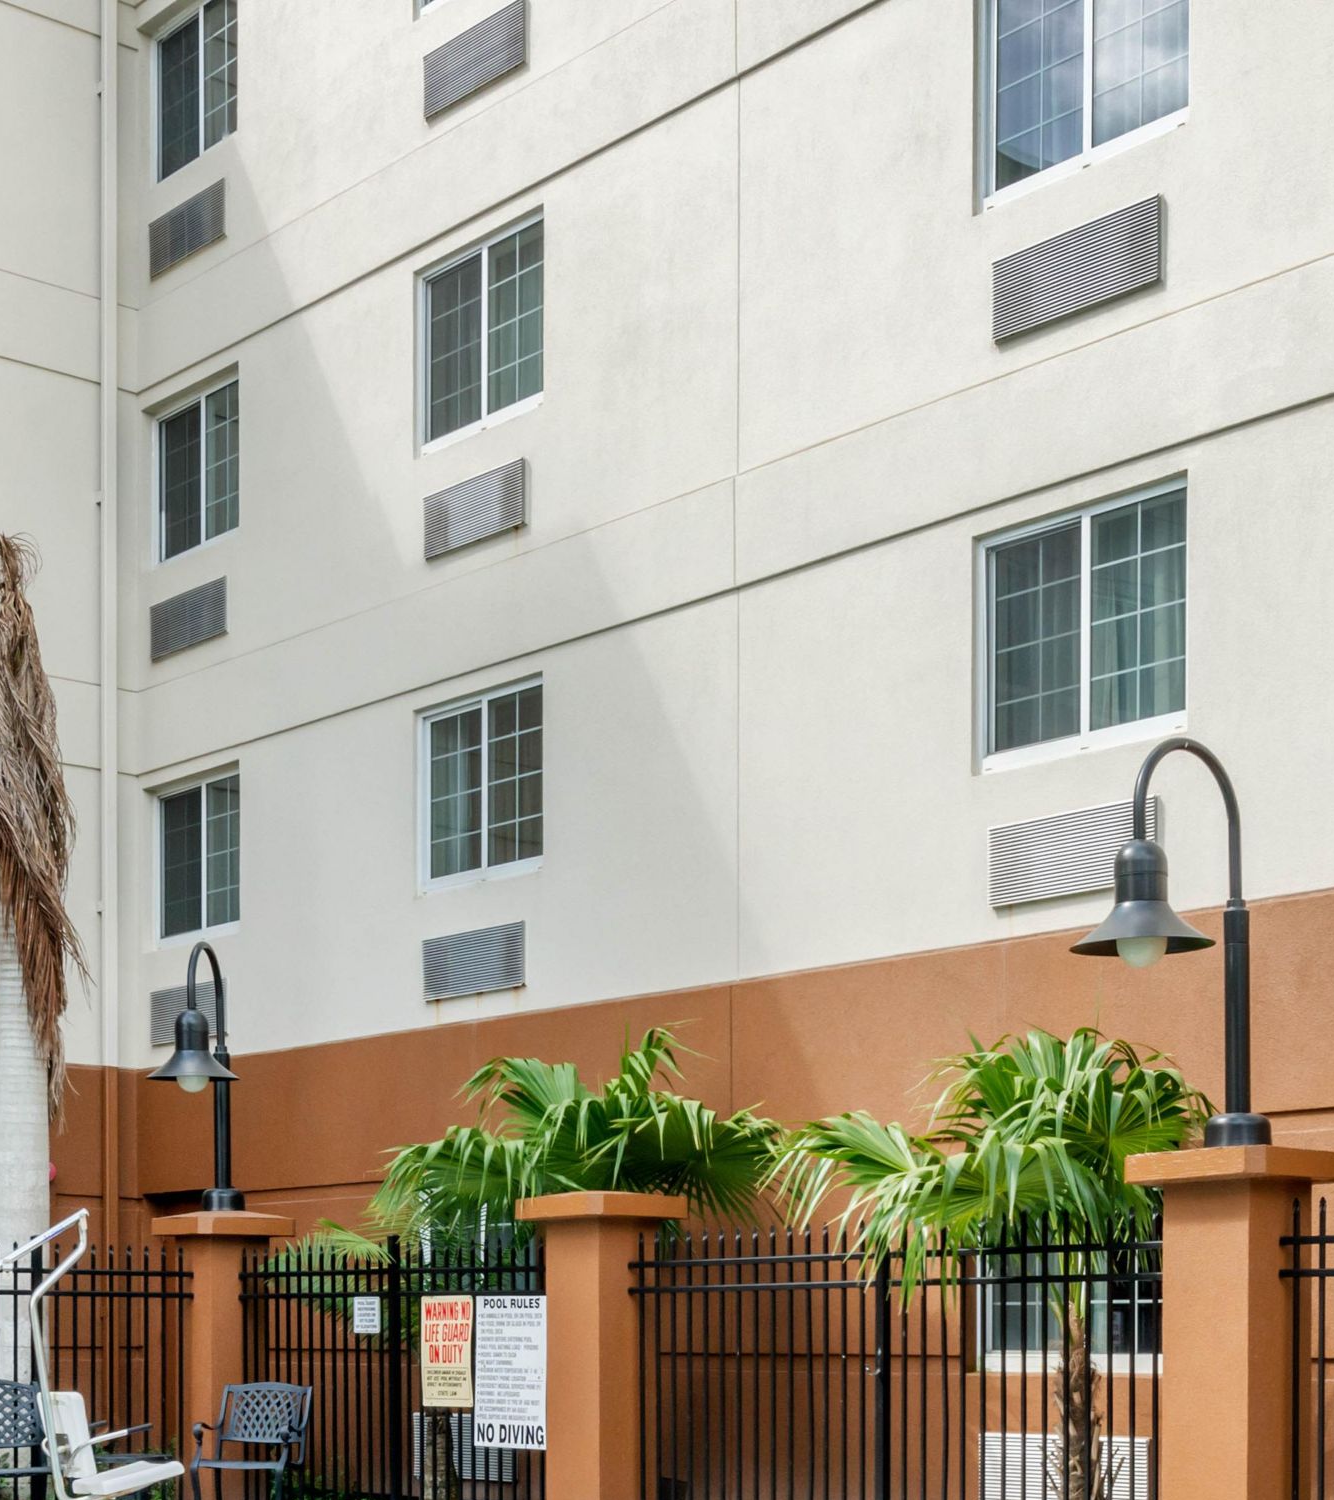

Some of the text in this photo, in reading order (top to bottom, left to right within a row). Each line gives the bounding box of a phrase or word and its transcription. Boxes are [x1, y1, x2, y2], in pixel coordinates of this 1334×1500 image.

[425, 1302, 471, 1320] WARNING NO
[483, 1298, 540, 1309] POOL RULES
[425, 1323, 470, 1342] LIFE GUARD
[429, 1345, 463, 1363] ON DUTY
[477, 1423, 544, 1445] NO DIVING
